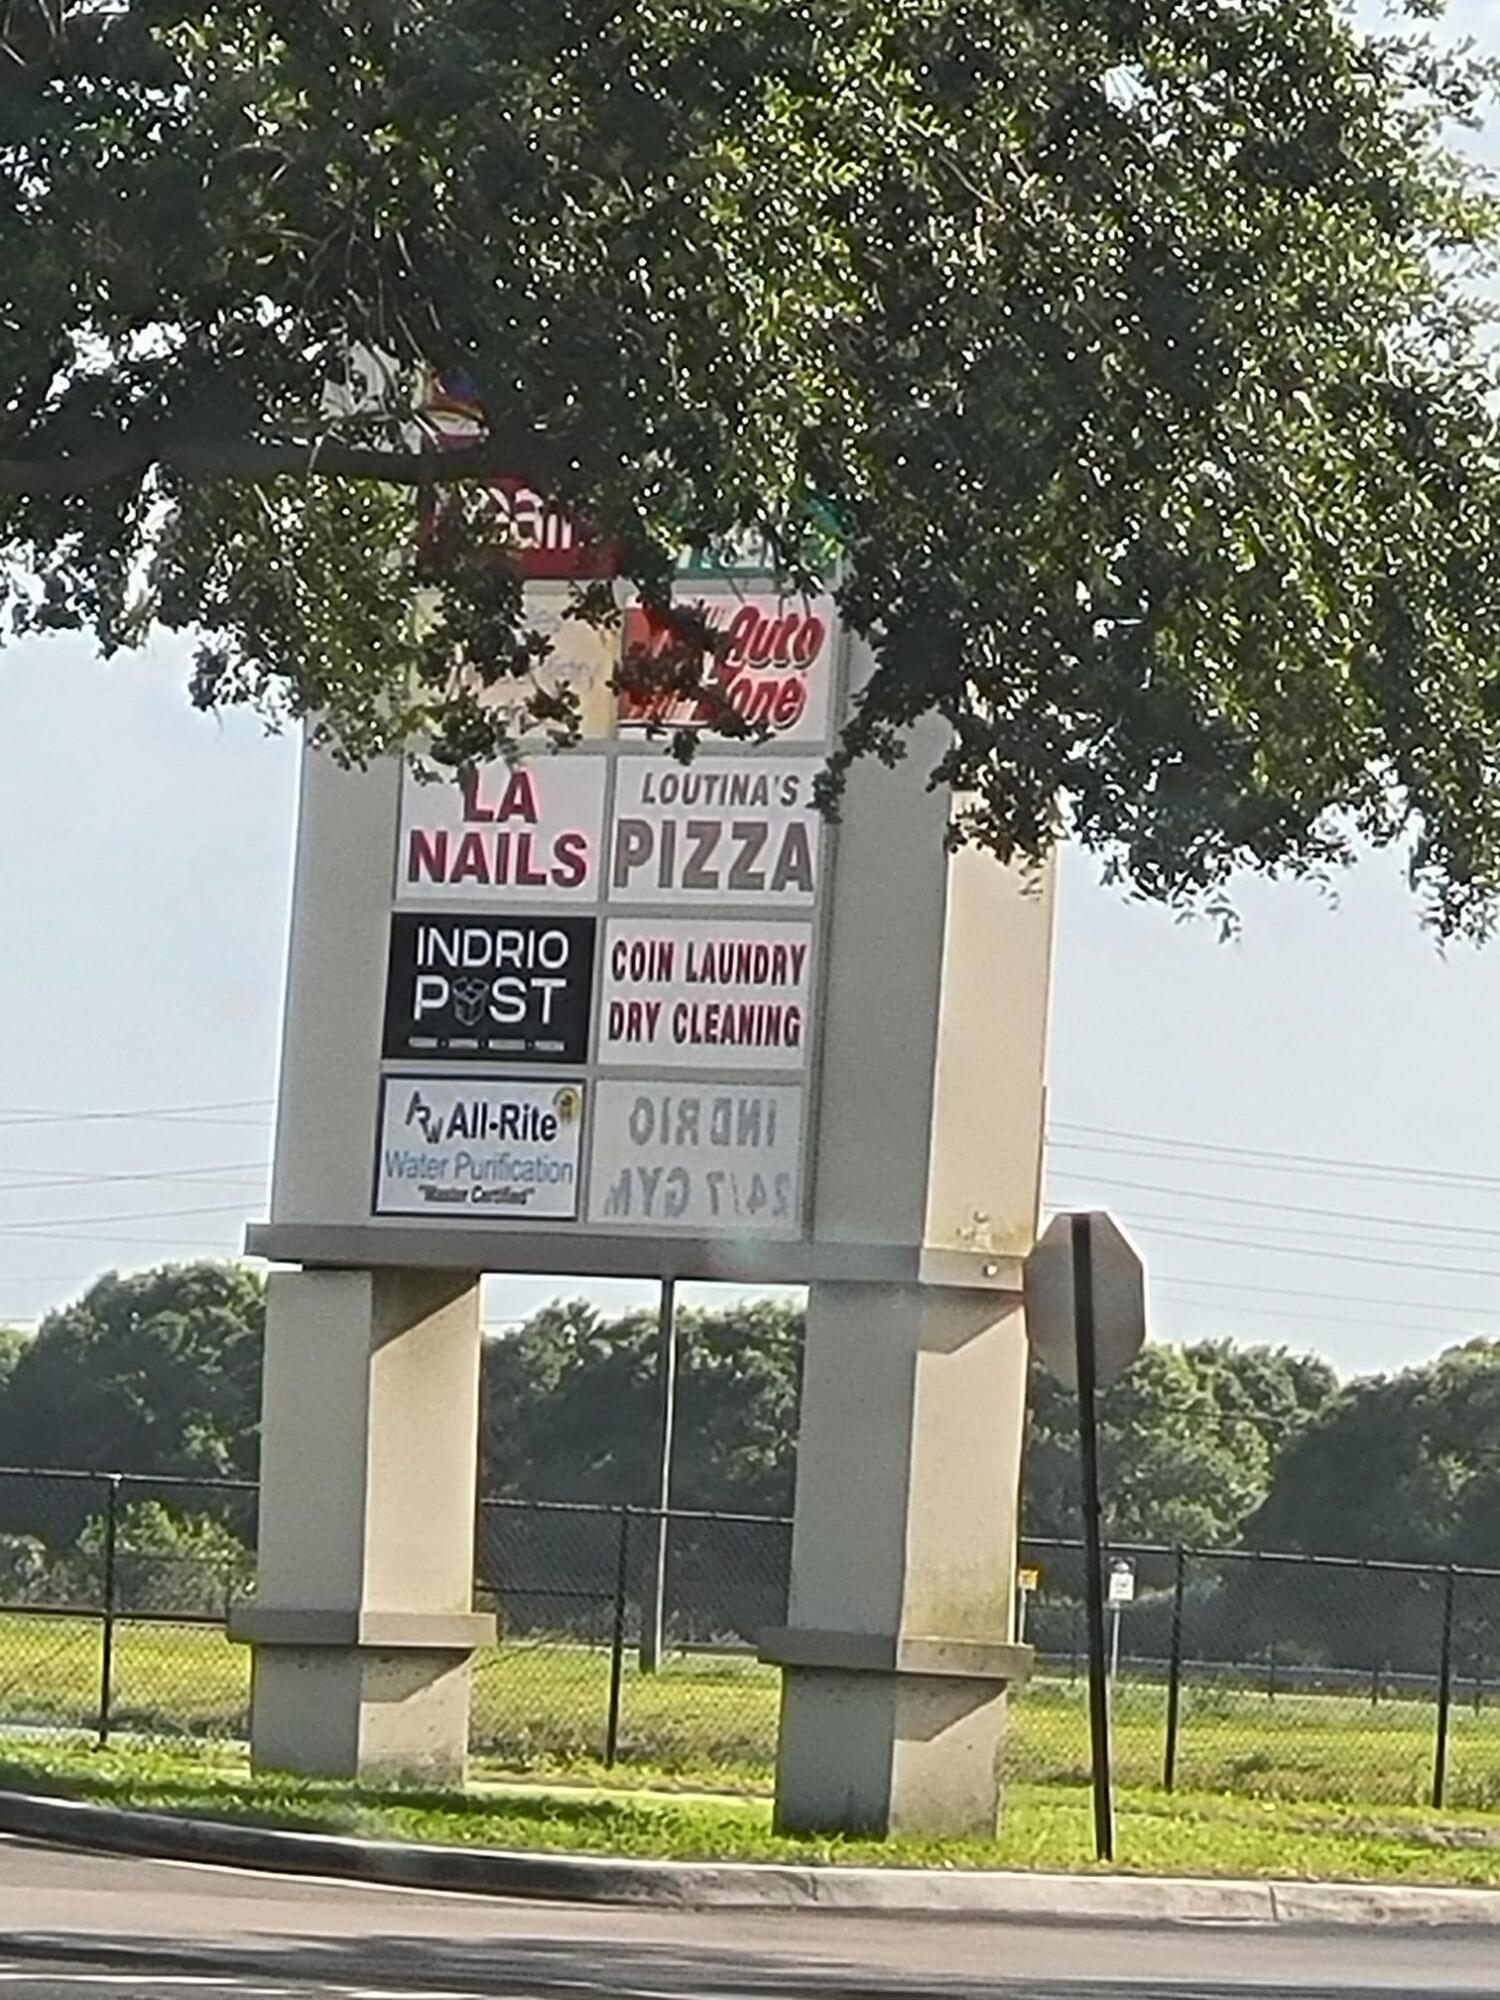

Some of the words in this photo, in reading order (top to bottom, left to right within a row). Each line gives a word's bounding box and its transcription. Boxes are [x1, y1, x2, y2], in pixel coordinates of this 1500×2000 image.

[727, 606, 827, 670] Auto
[720, 672, 807, 731] one
[463, 767, 538, 824] LA
[642, 772, 800, 807] LOUTINA'S
[408, 829, 588, 889] NAILS
[613, 818, 814, 892] PIZZA
[416, 926, 569, 969] INDRIO
[611, 940, 675, 983] COIN
[685, 941, 806, 987] LAUNDRY
[608, 1001, 661, 1044] DRY
[672, 1002, 801, 1047] CLEANING
[385, 1150, 449, 1181] Water
[454, 1150, 574, 1184] Purification
